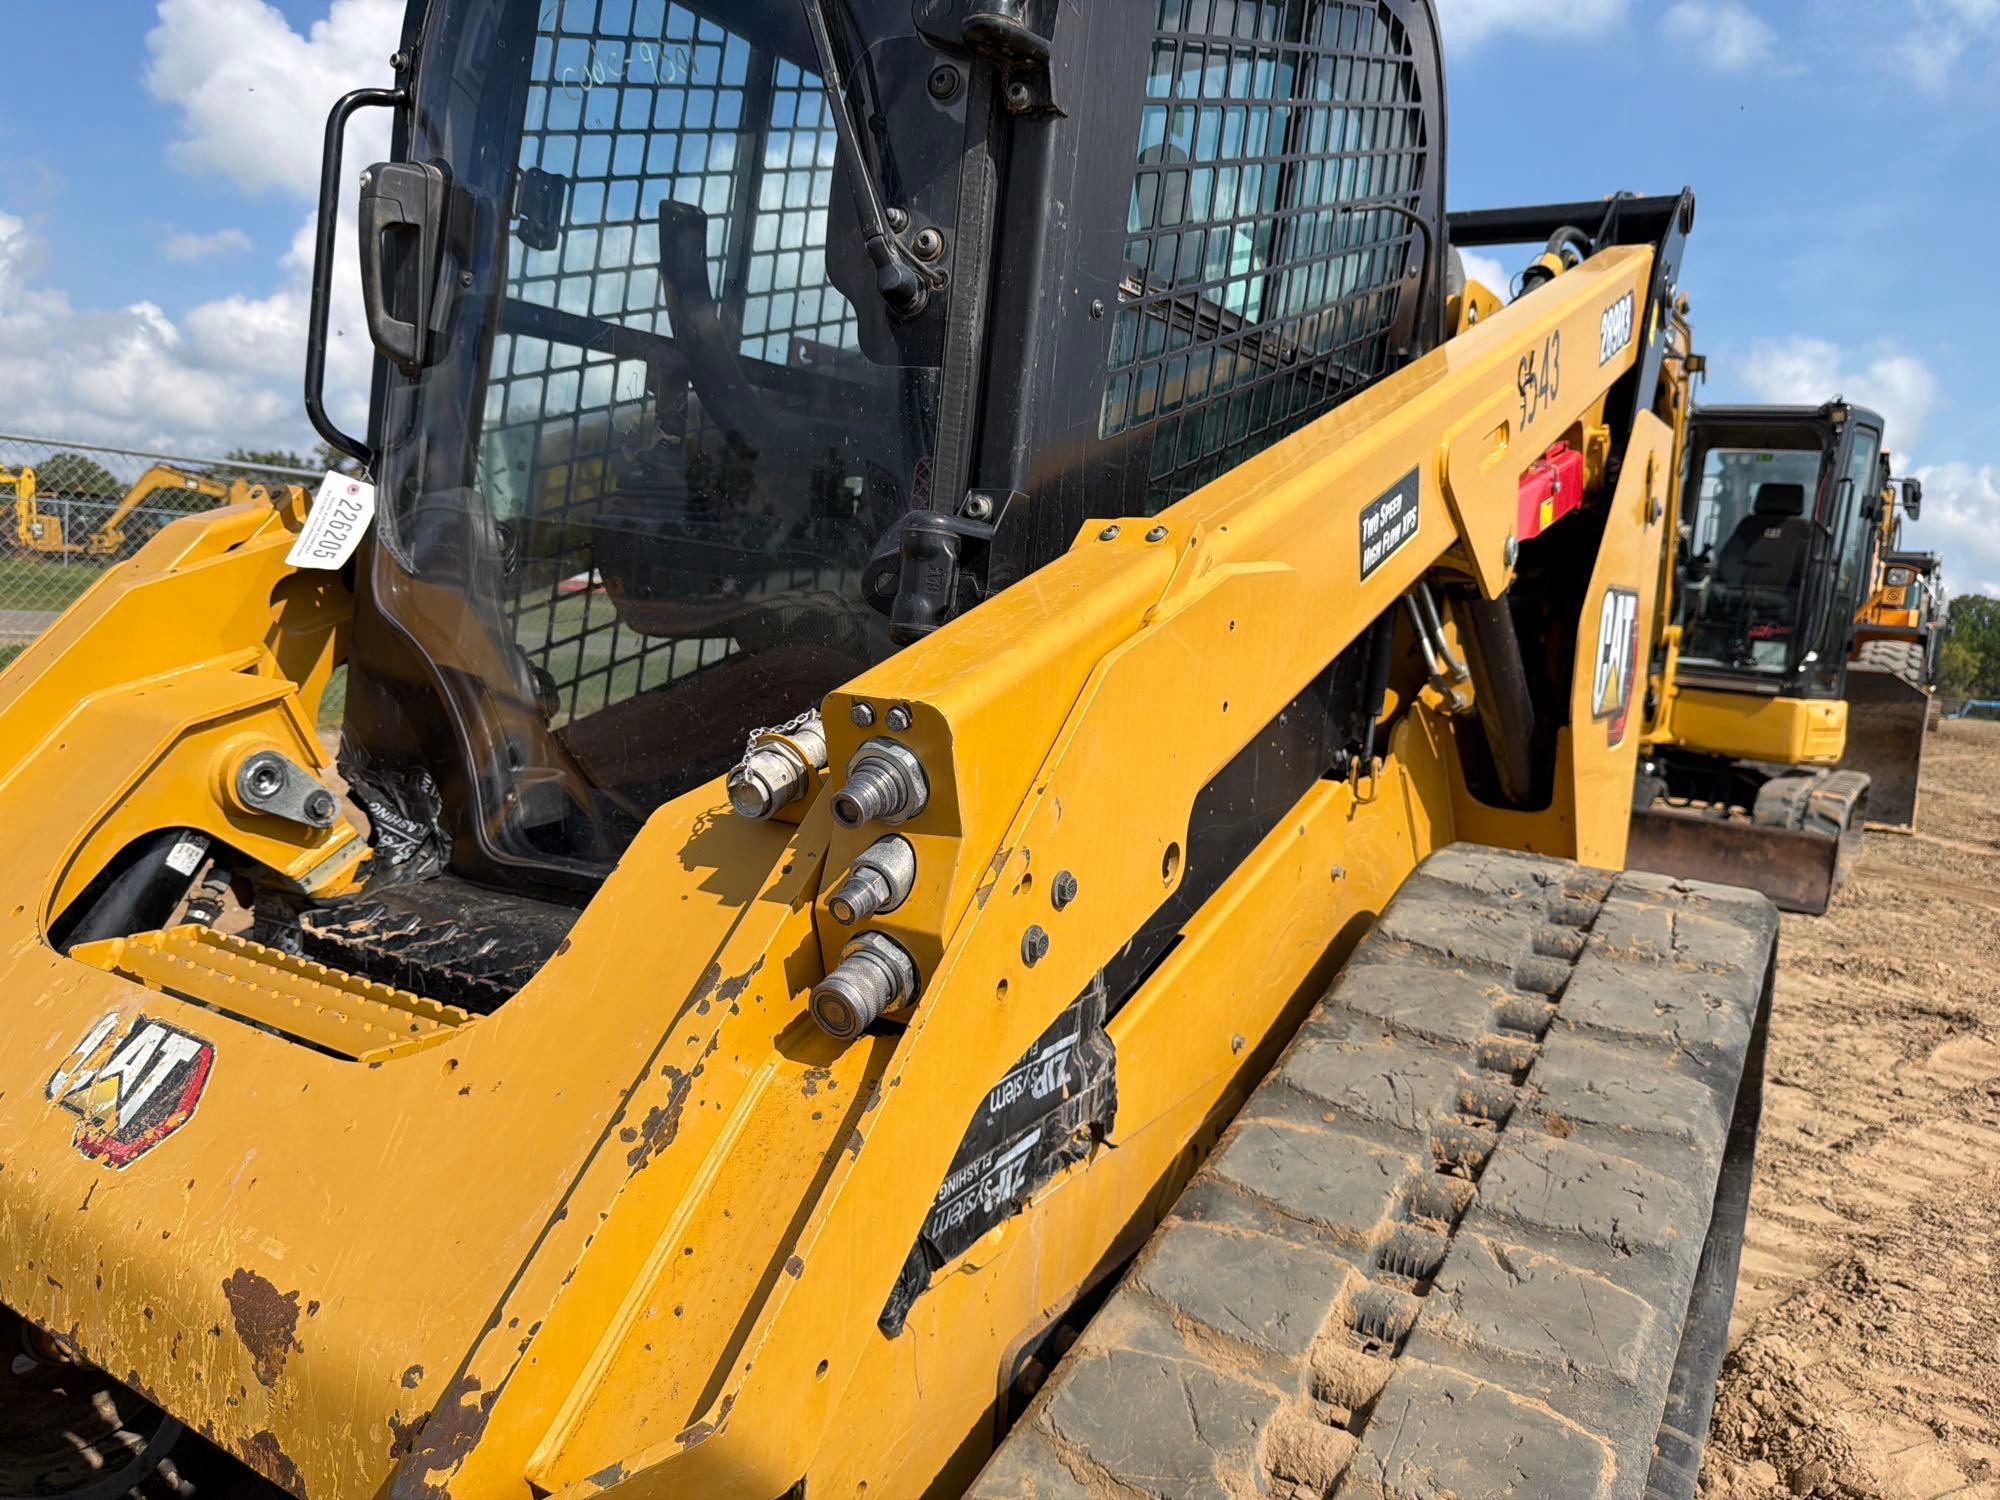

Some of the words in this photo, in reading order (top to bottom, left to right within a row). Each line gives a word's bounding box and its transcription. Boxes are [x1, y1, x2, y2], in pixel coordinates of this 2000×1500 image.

[313, 498, 363, 559] 226205
[1593, 591, 1636, 715] CAT
[50, 1012, 202, 1130] CAT
[939, 1151, 993, 1201] FLASHING
